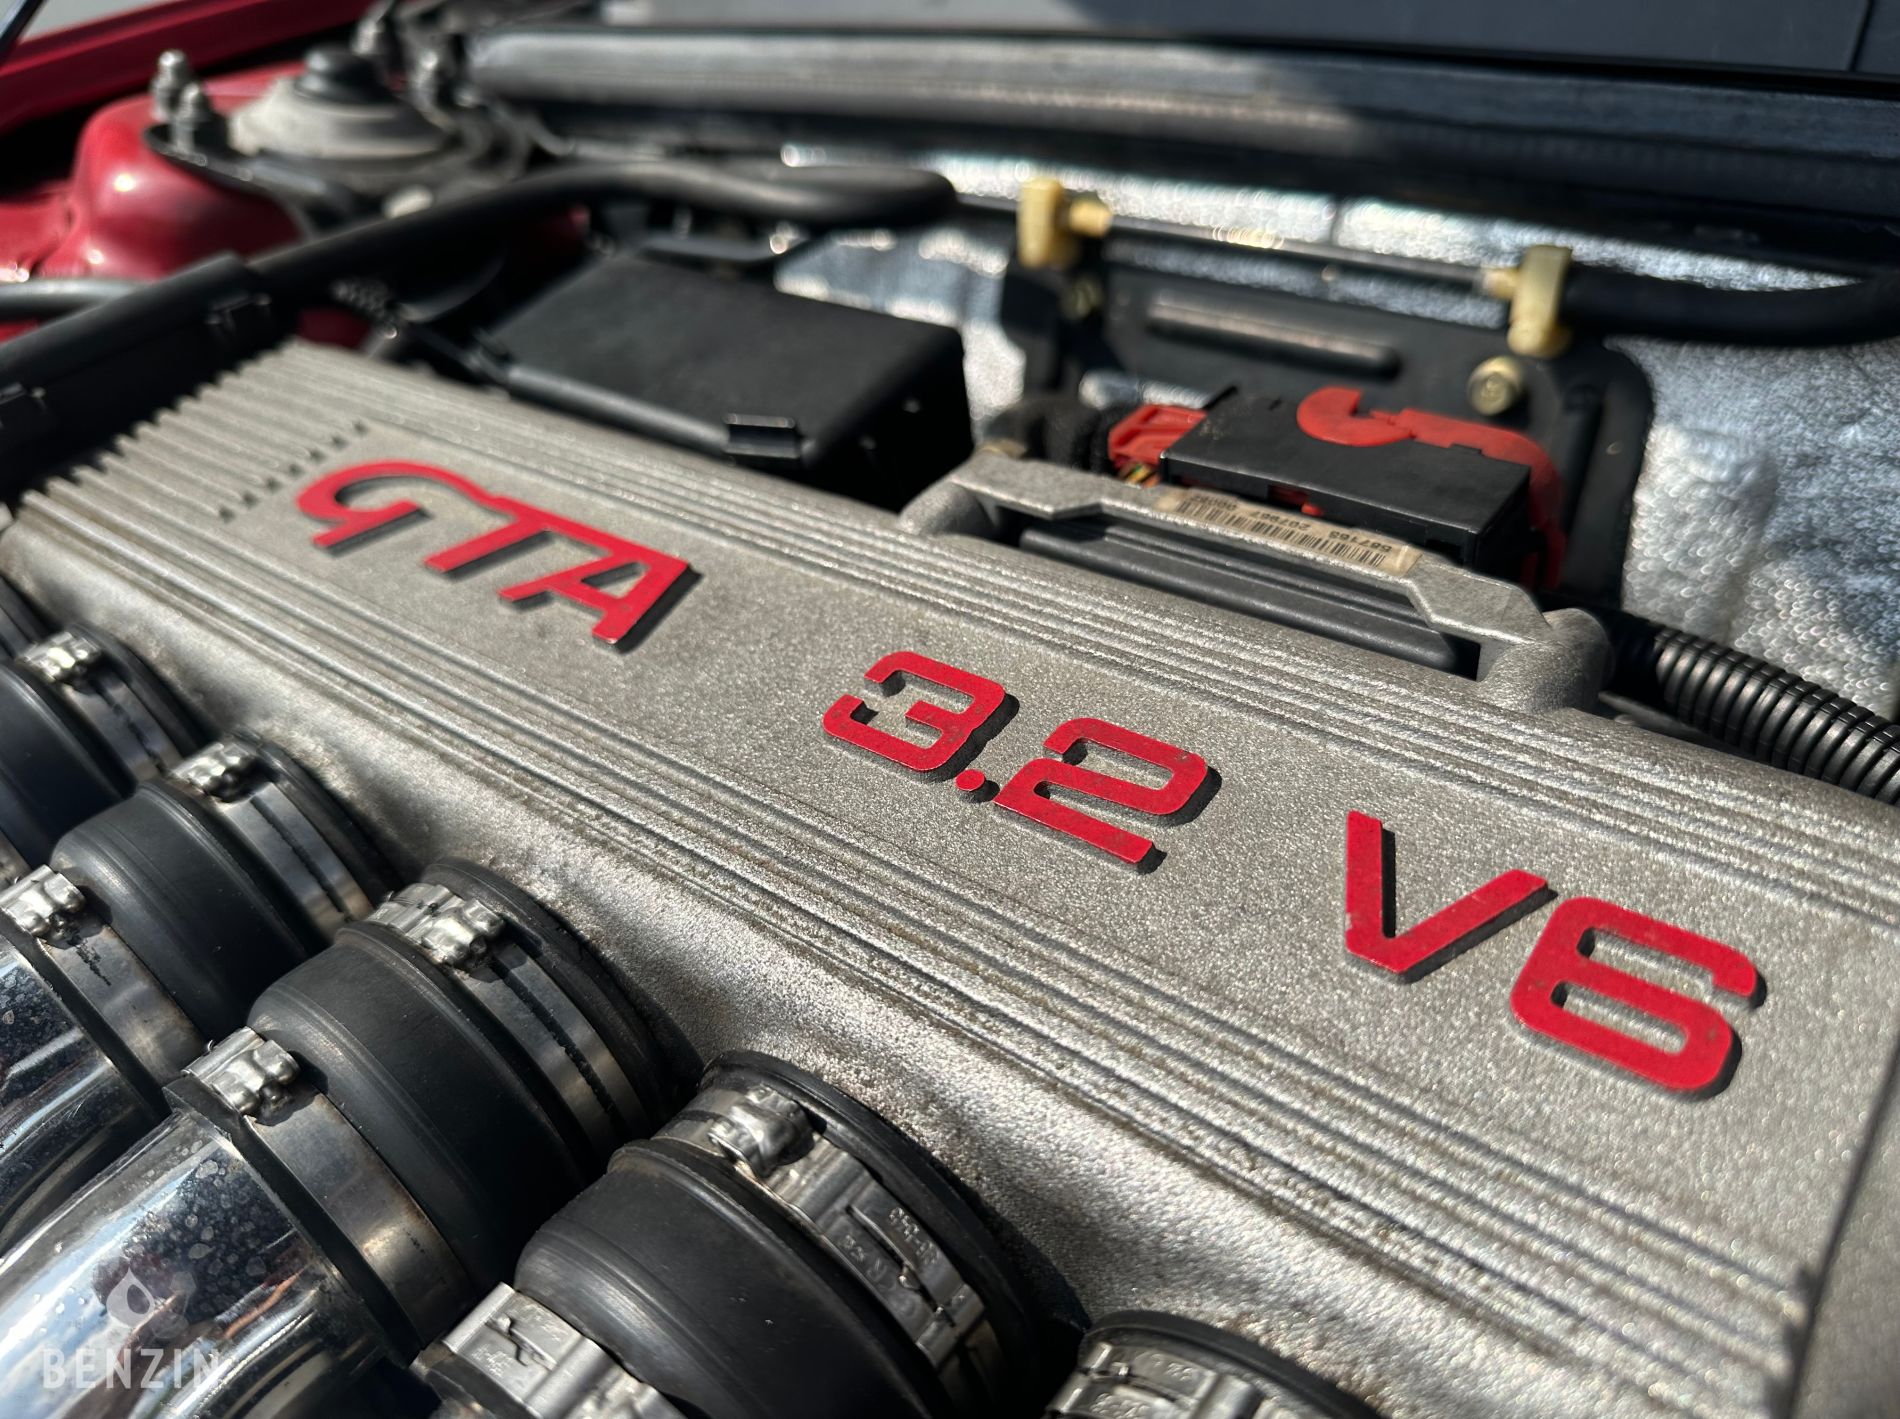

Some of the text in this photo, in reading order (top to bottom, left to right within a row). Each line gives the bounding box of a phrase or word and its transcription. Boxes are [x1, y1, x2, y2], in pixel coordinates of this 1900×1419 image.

[296, 459, 1757, 1089] GTA 3.2 V6
